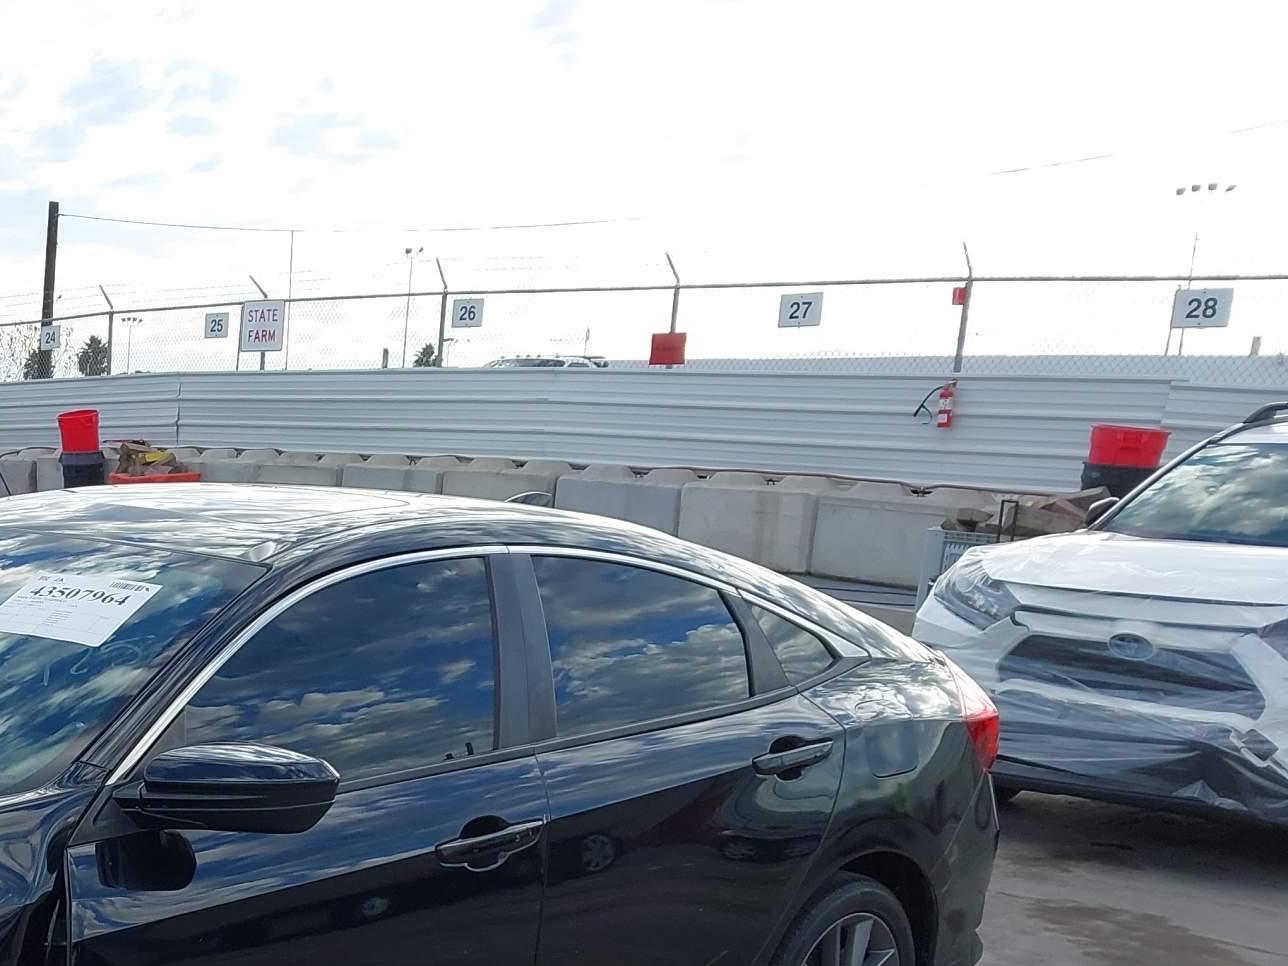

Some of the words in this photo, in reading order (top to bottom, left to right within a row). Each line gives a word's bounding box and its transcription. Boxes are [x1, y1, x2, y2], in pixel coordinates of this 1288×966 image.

[247, 308, 279, 323] STATE
[459, 306, 476, 321] 26
[788, 301, 813, 320] 27
[1184, 298, 1217, 318] 28
[210, 319, 224, 333] 25
[45, 329, 56, 344] 24
[247, 328, 277, 344] FARM
[30, 585, 131, 606] 43507964
